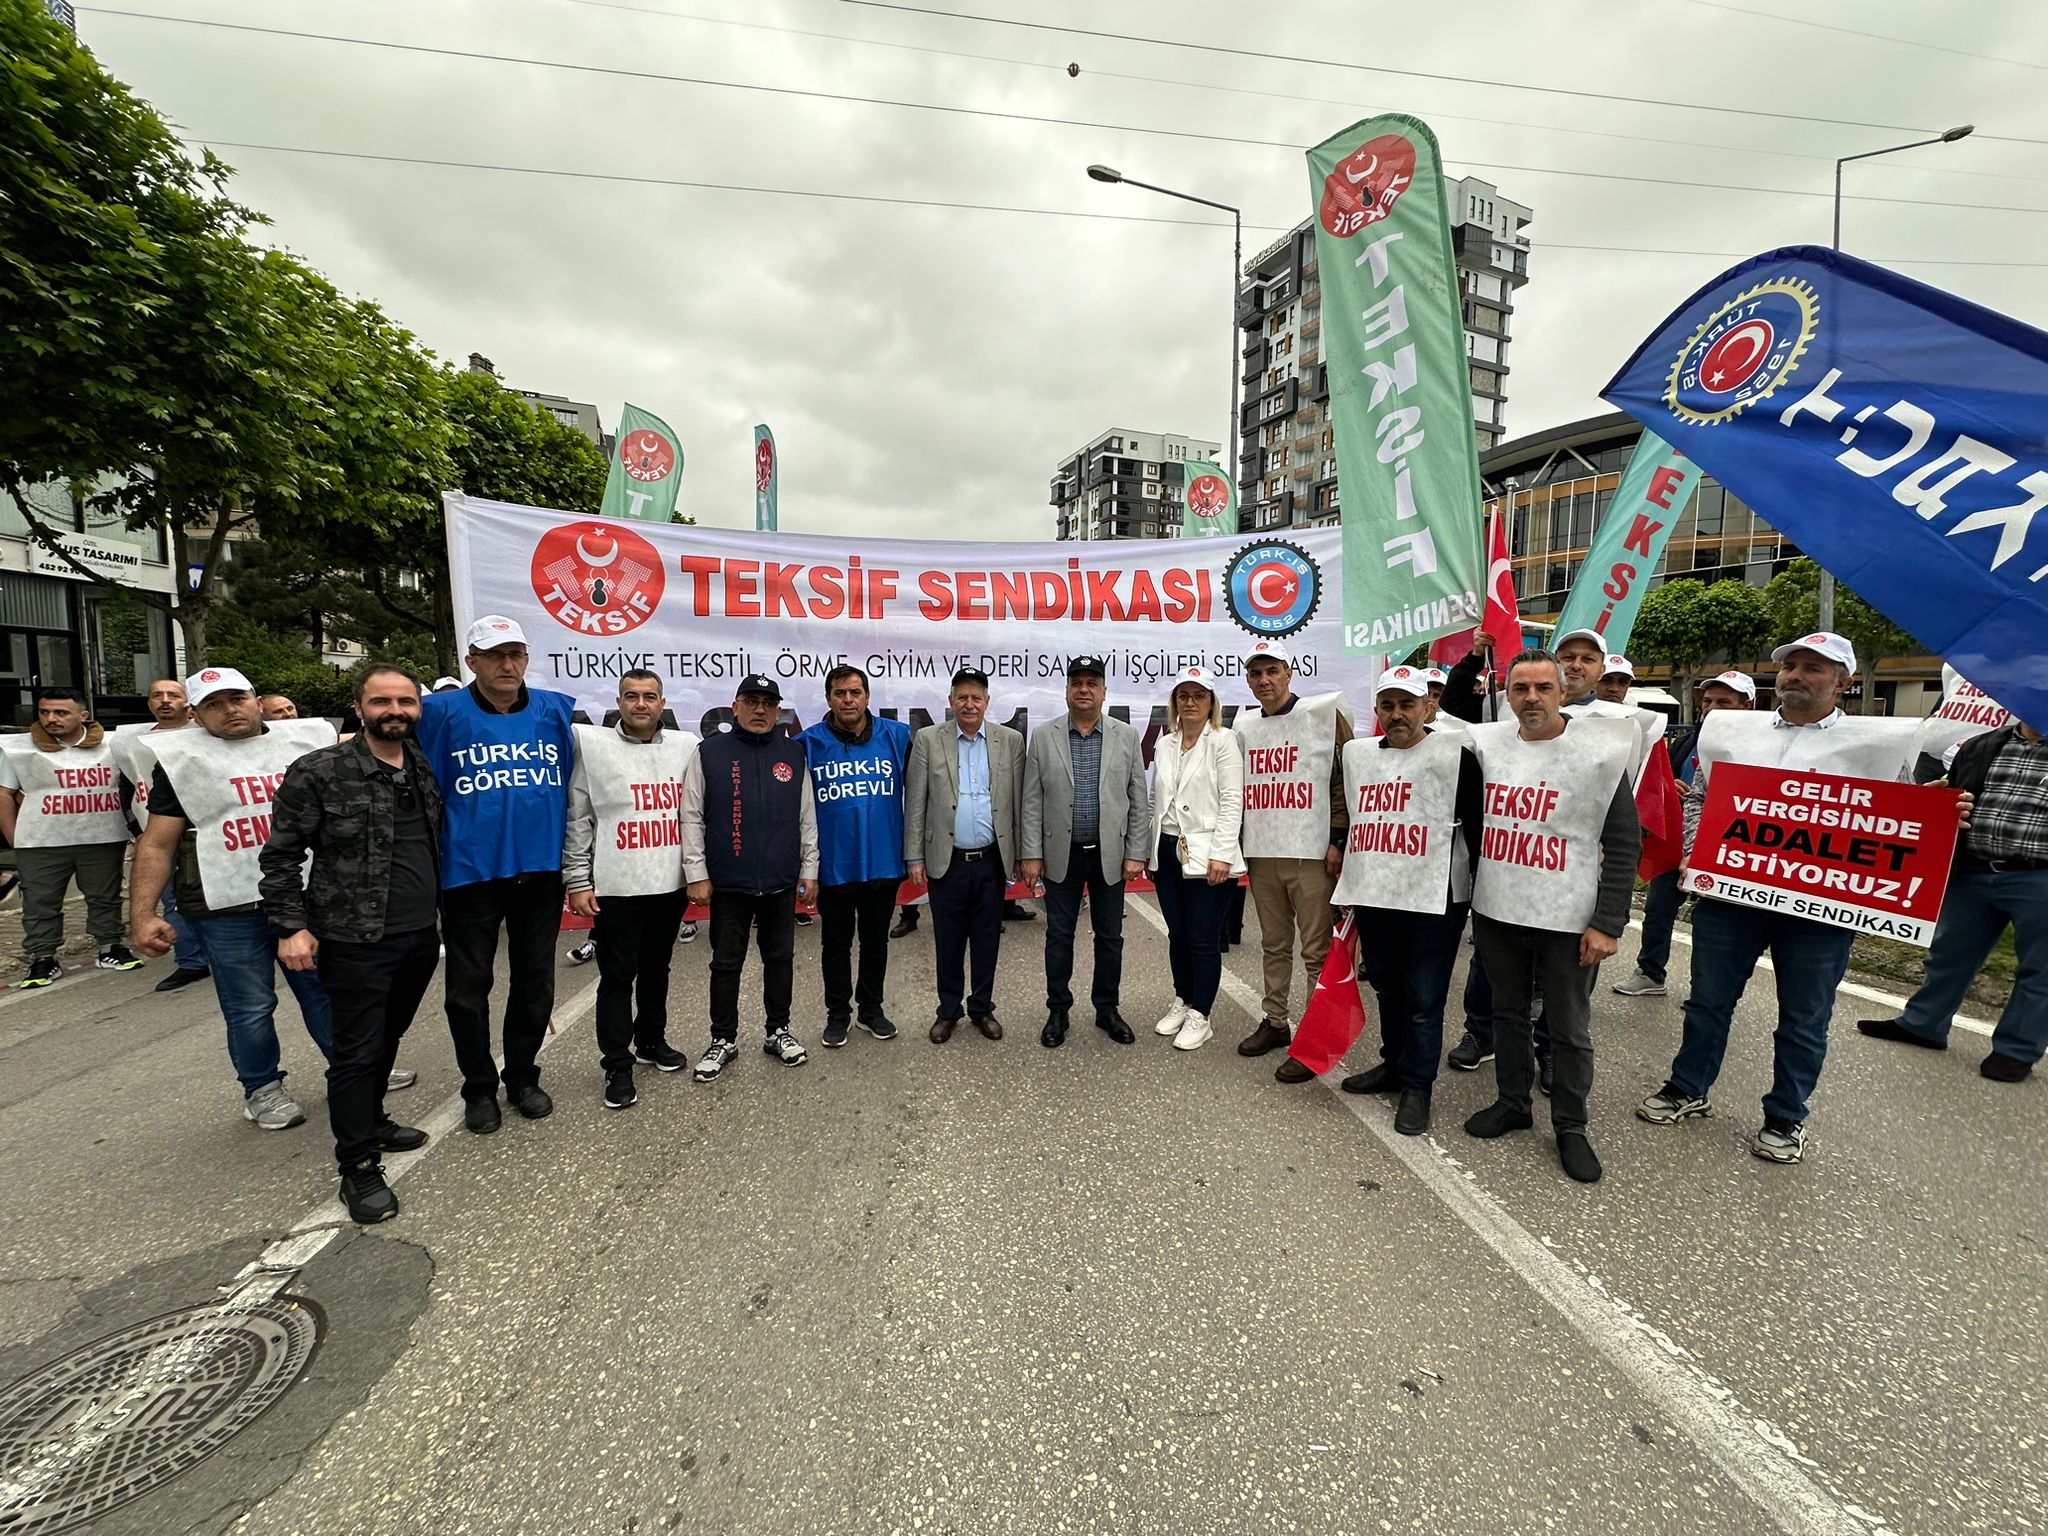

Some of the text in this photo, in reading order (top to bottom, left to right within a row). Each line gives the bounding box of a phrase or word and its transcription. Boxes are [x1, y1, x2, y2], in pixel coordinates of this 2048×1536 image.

[39, 563, 56, 571] 452
[57, 565, 68, 573] 92
[83, 548, 138, 566] TASARIMI
[681, 555, 1213, 623] TEKSİF SENDİKASI
[543, 583, 652, 633] TEKSİF
[1250, 614, 1295, 628] 1952
[549, 646, 655, 678] TÜRKİYE
[865, 648, 936, 678] GİYİM
[943, 655, 971, 678] VE
[980, 648, 1015, 678] DERİ
[451, 739, 559, 768] TÜRK-İŞ
[1249, 740, 1299, 775] TEKSİF
[54, 763, 112, 789] TEKSİF
[454, 765, 562, 796] GÖREVLİ
[813, 757, 893, 782] TÜRK-İŞ
[41, 790, 121, 815] SENDİKAS
[817, 778, 895, 803] GÖREVLİ
[1358, 776, 1412, 813] TEKSİF
[1484, 781, 1559, 823] TEKSİF
[1780, 780, 1872, 808] GELİR
[1733, 796, 1922, 841] VERGİSİNDE
[1722, 818, 1917, 872] ADALET
[1717, 881, 1921, 941] TEKSİF SENDİKASI
